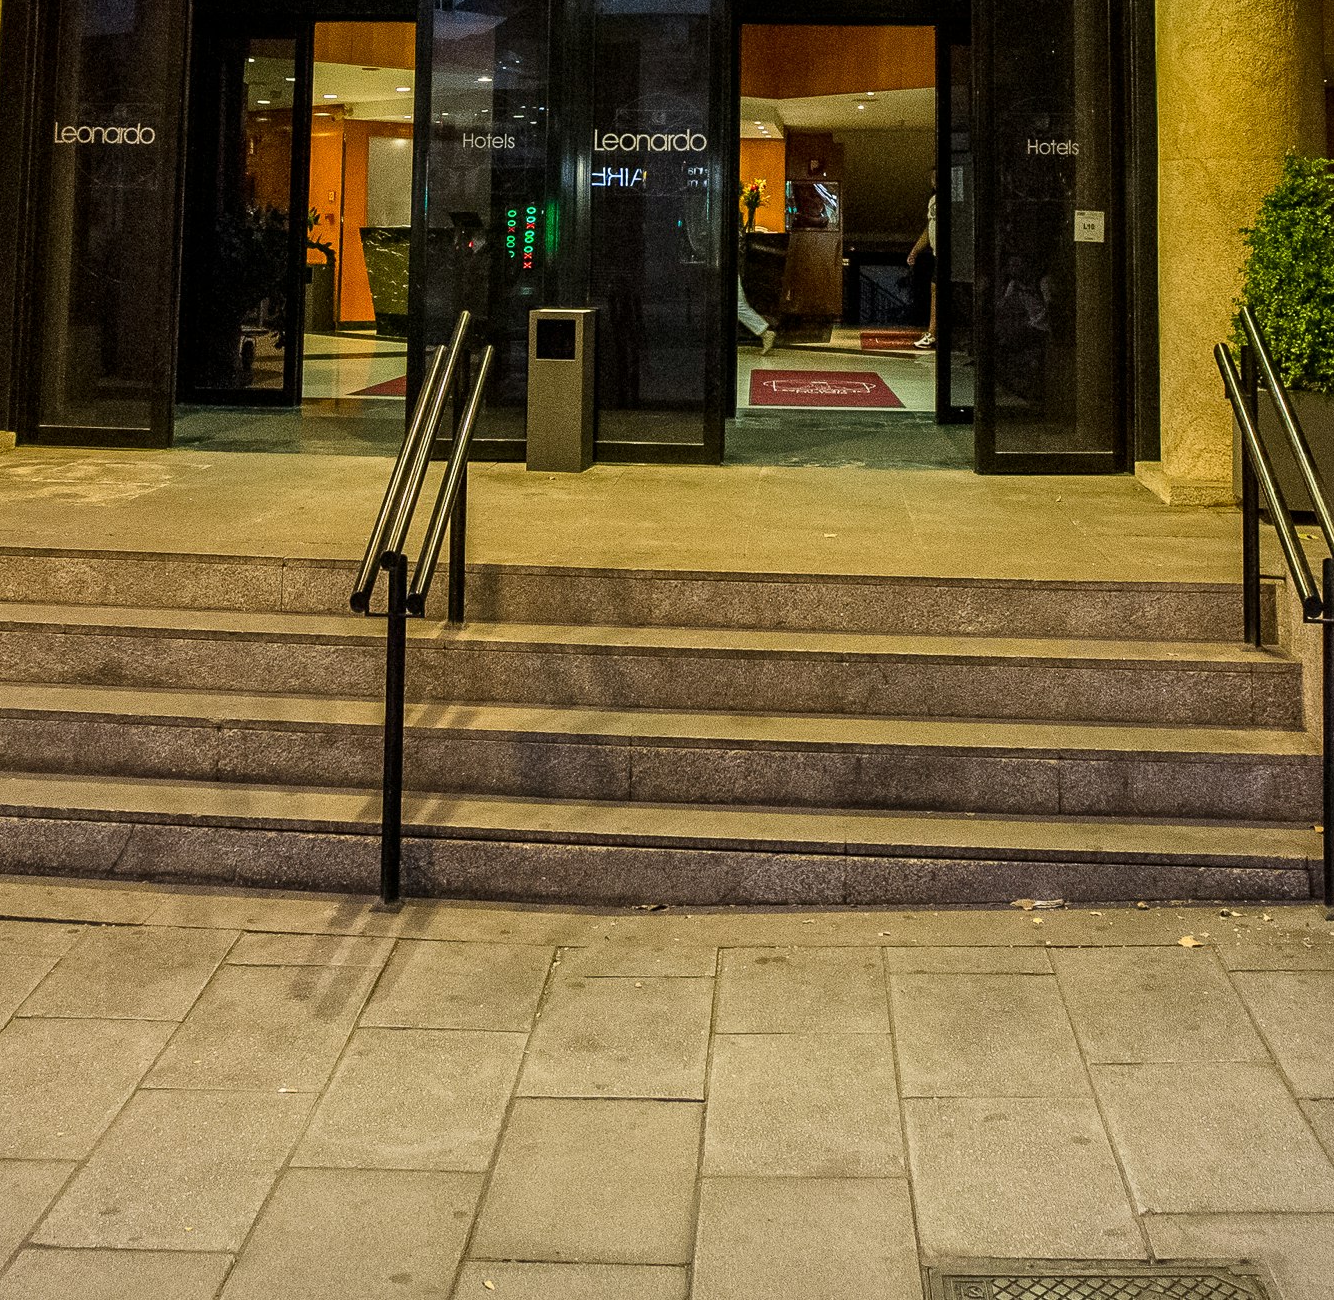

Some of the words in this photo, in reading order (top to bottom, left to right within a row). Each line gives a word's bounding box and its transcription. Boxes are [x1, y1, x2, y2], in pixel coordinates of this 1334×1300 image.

[54, 122, 156, 145] Leonardo
[462, 133, 516, 149] Hotels
[594, 129, 708, 152] Leonardo
[1027, 139, 1080, 155] Hotels
